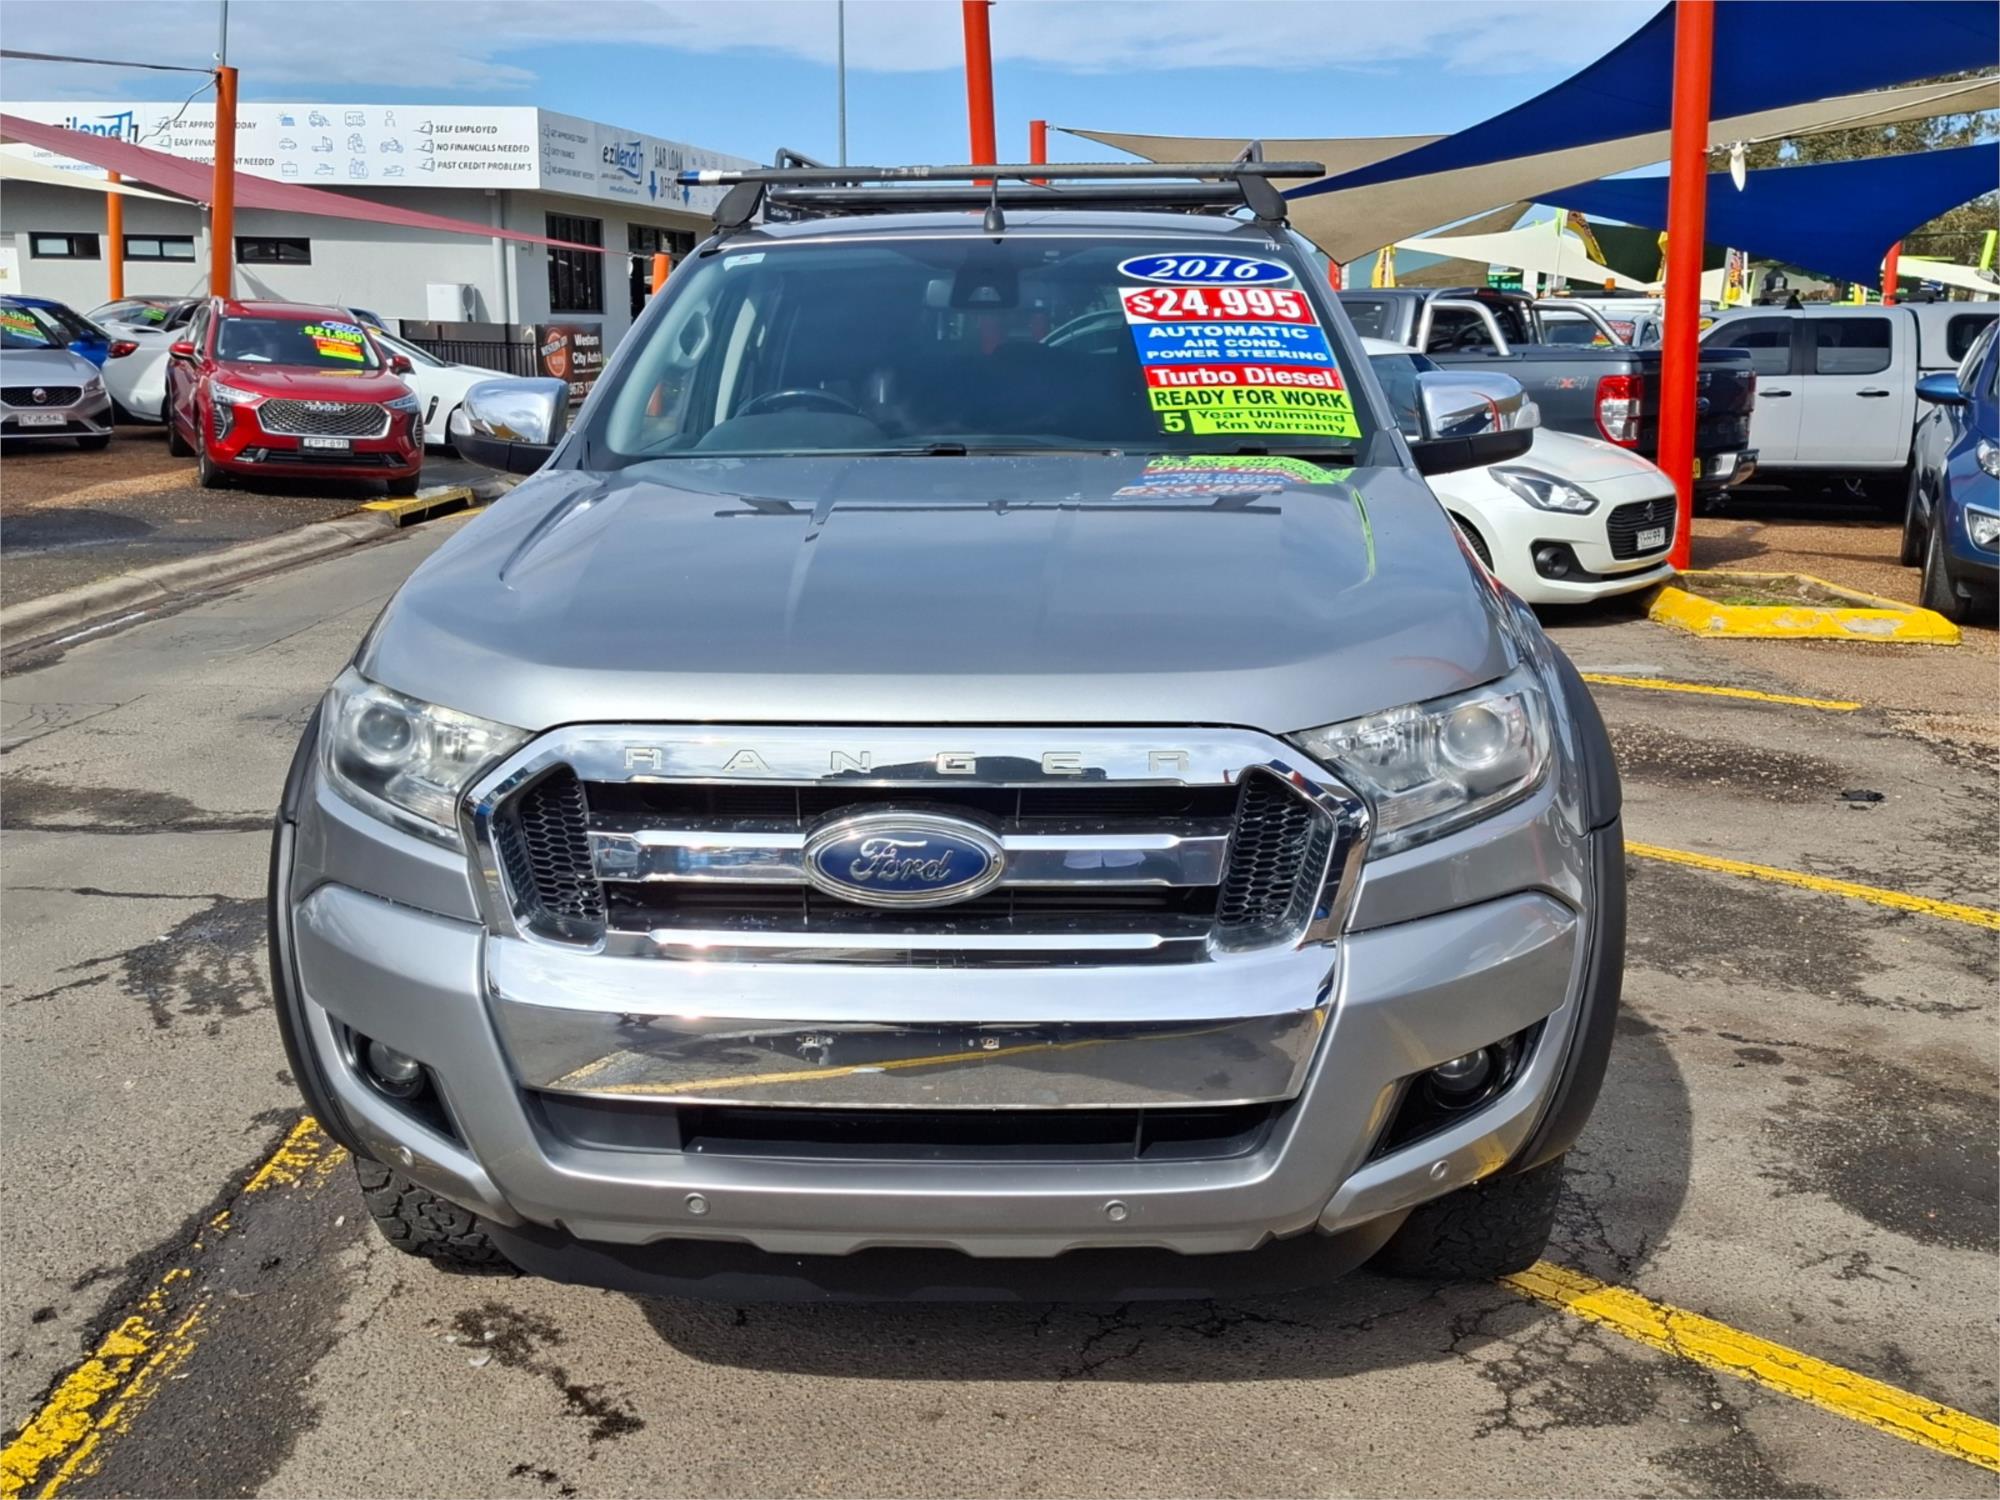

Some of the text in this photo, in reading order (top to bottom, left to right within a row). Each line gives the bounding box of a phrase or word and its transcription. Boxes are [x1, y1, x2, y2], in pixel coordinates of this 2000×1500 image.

[173, 121, 188, 129] GET
[435, 125, 498, 134] SELF EMPLOYED
[174, 138, 193, 147] EASY
[436, 143, 530, 153] NO FINANCIALS NEEDED
[244, 157, 275, 167] NEEDED
[602, 141, 637, 169] ezilend
[437, 161, 457, 169] PAST
[458, 161, 486, 170] CREDIT
[1148, 258, 1260, 280] 2016
[1130, 288, 1303, 320] $24,995
[1148, 325, 1310, 340] AUTOMATIC
[573, 334, 600, 346] Western
[1183, 338, 1288, 349] AIR COND.
[571, 352, 588, 367] City
[1146, 349, 1328, 362] POWER STEERING
[1151, 367, 1335, 388] Turbo Diesel
[1154, 389, 1347, 409] READY FOR WORK
[1162, 411, 1186, 433] 5
[1197, 410, 1346, 424] Year Unlimited
[1215, 420, 1346, 434] Km Warranty
[623, 745, 1192, 776] RANGER
[850, 837, 952, 883] Ford
